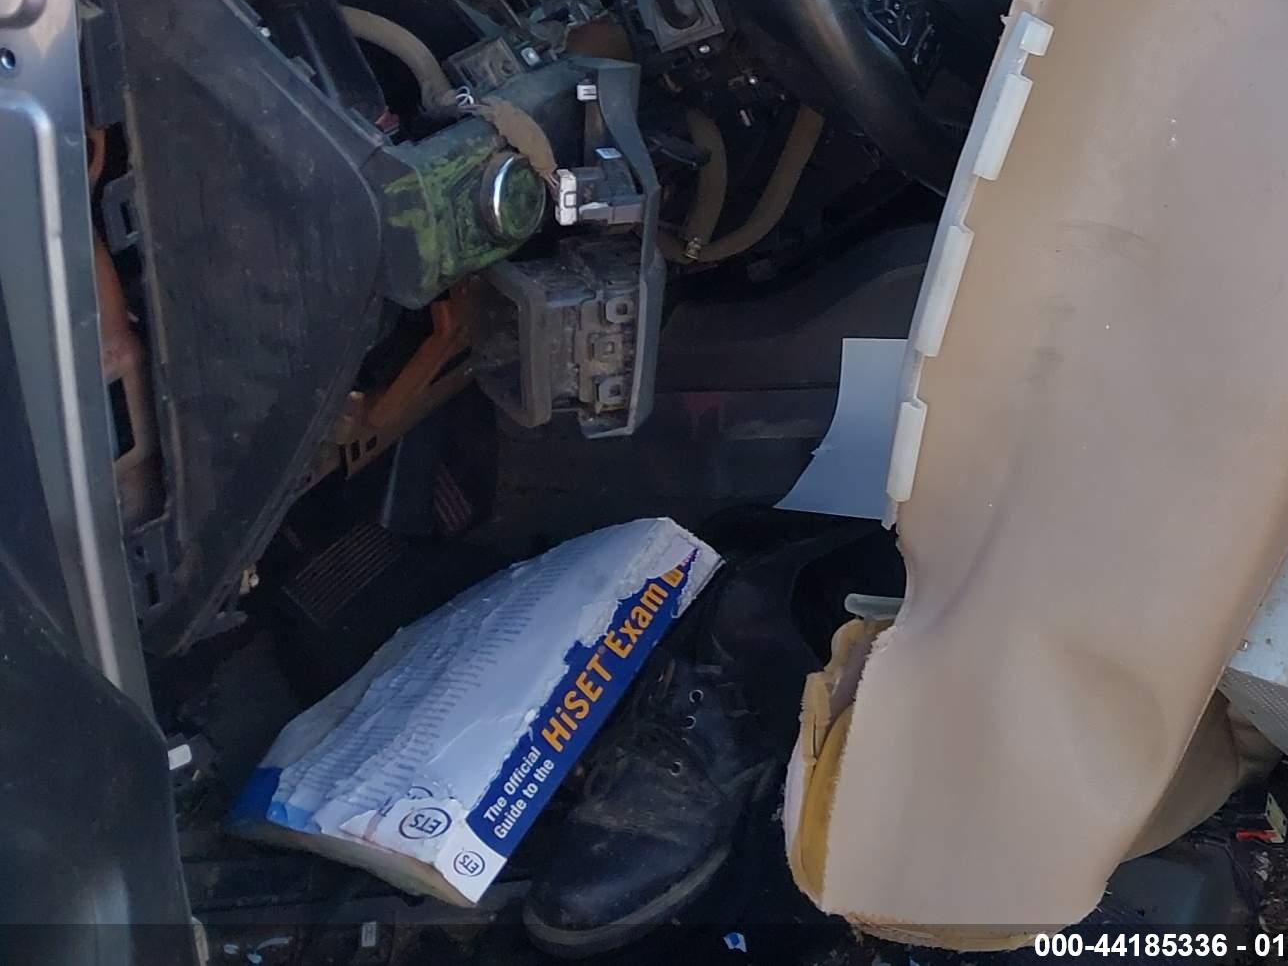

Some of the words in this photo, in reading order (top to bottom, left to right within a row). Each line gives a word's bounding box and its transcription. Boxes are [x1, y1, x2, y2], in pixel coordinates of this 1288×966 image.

[541, 652, 612, 753] HiSET
[603, 583, 669, 659] Exam
[483, 795, 508, 823] The
[503, 745, 542, 795] Official
[493, 798, 527, 839] Guide
[522, 781, 539, 799] to
[533, 757, 555, 783] the
[409, 813, 443, 835] ETS
[458, 854, 480, 875] ETS
